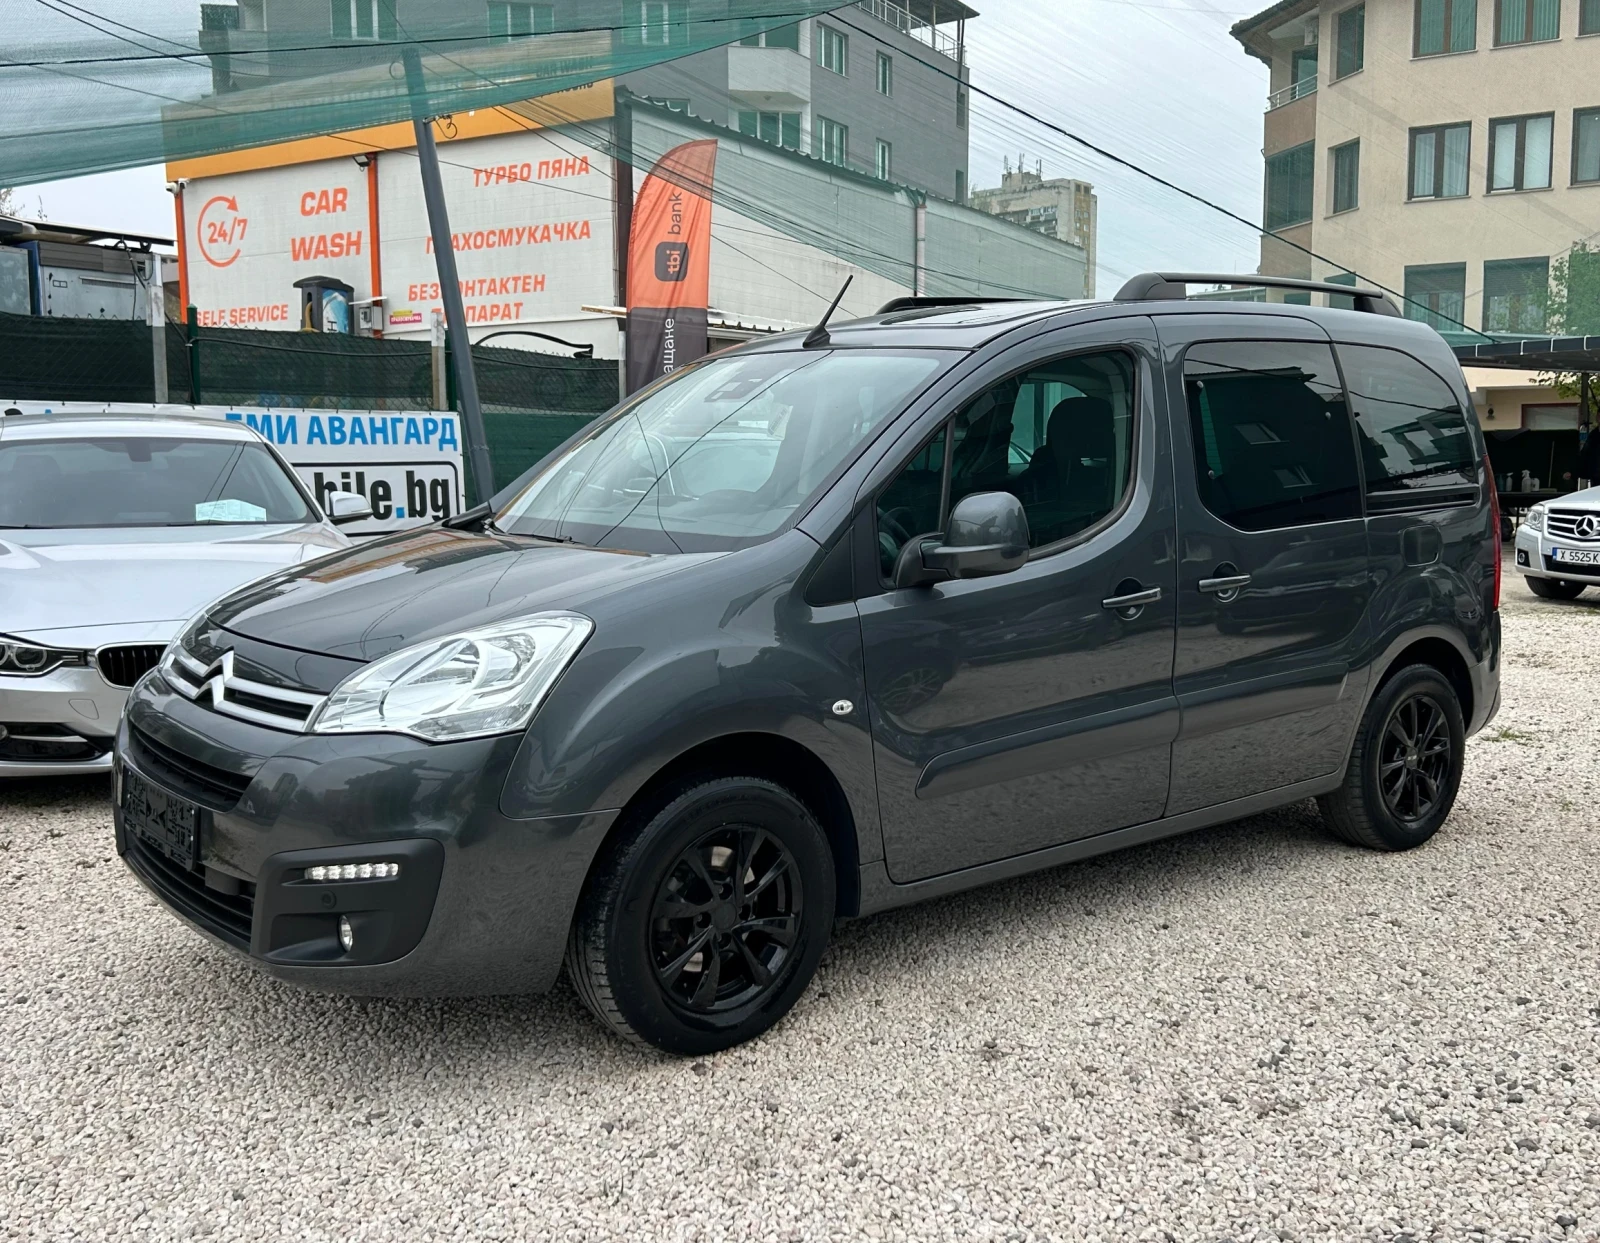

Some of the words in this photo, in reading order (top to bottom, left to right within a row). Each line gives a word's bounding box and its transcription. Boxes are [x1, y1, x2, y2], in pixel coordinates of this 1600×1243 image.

[474, 163, 531, 187] ТУРБО
[537, 156, 590, 180] ПЯНА
[301, 187, 348, 216] CAR
[669, 192, 683, 235] bank
[207, 217, 248, 245] 24/7
[426, 220, 591, 254] ПАХОСМУКАЧКА
[291, 231, 362, 261] WASH
[667, 249, 682, 274] tbi
[408, 274, 546, 301] БЕЗНТАКТЕН
[197, 309, 226, 326] SELF
[229, 304, 288, 324] SERVICE
[306, 415, 457, 451] АВАНГАРД
[1569, 551, 1591, 562] 5525
